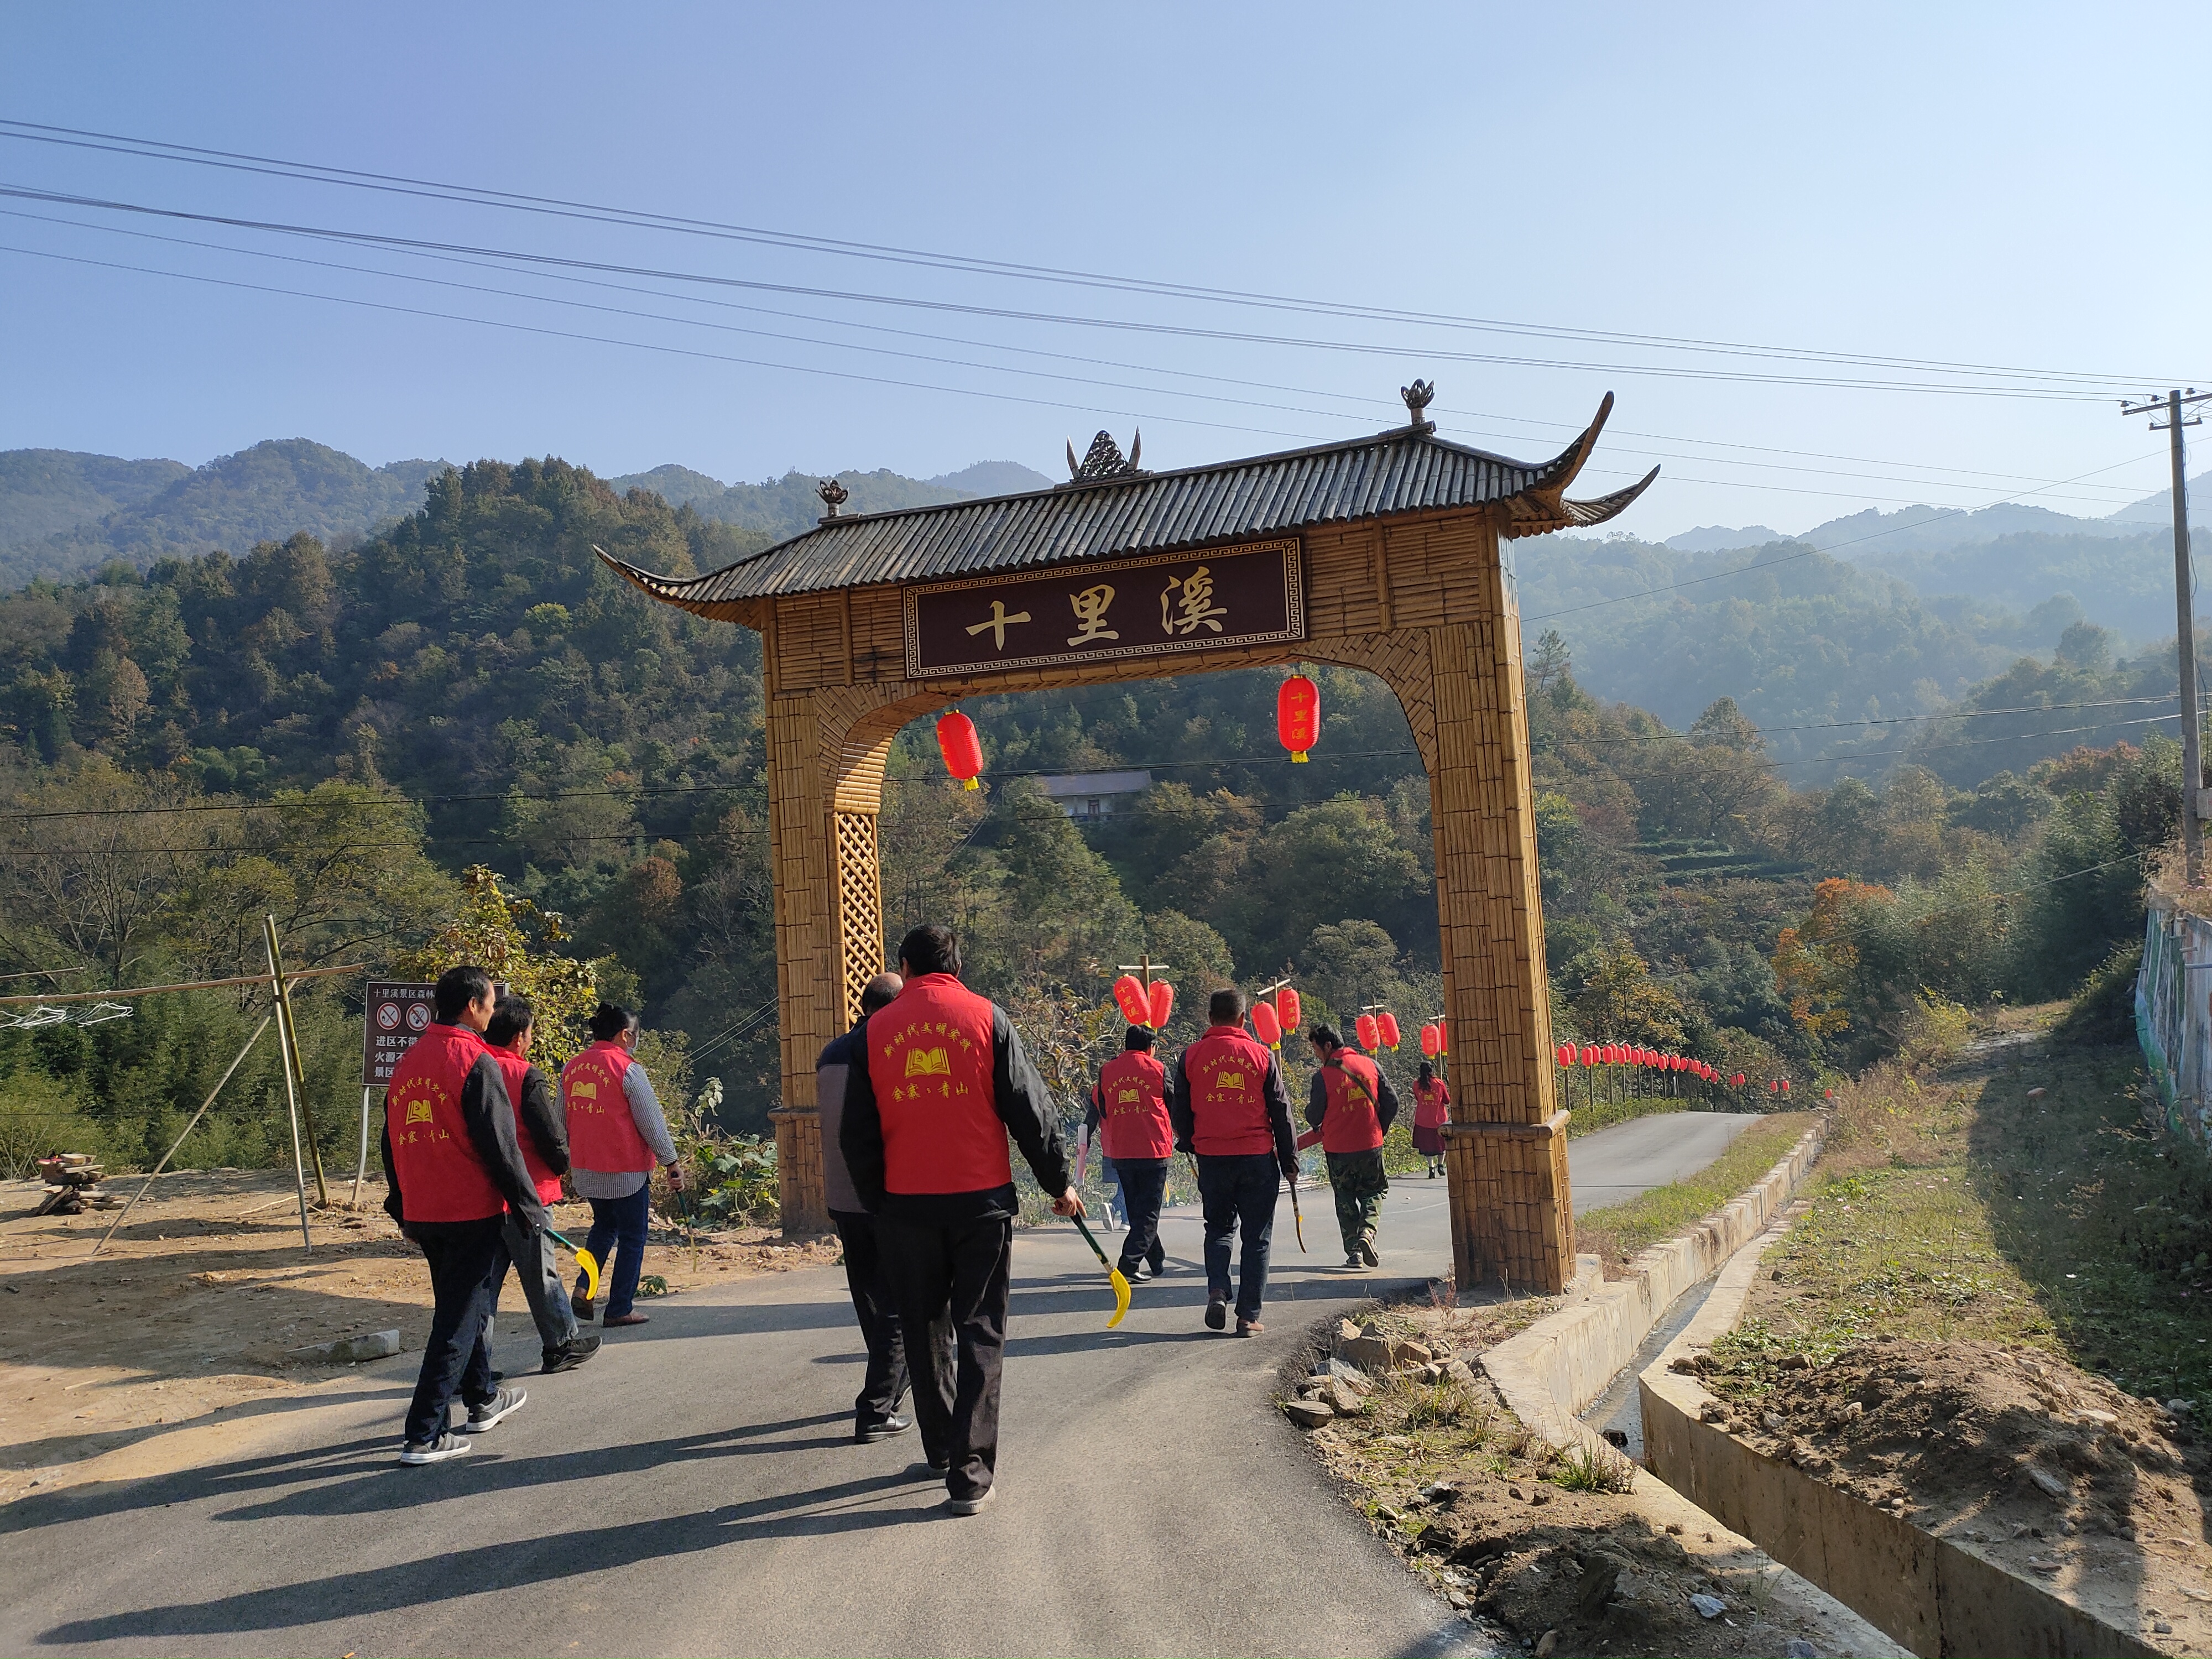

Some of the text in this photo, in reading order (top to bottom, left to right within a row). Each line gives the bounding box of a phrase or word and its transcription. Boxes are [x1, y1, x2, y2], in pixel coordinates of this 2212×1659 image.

[964, 566, 1228, 651] 十里溪
[1290, 692, 1310, 740] 十里溪
